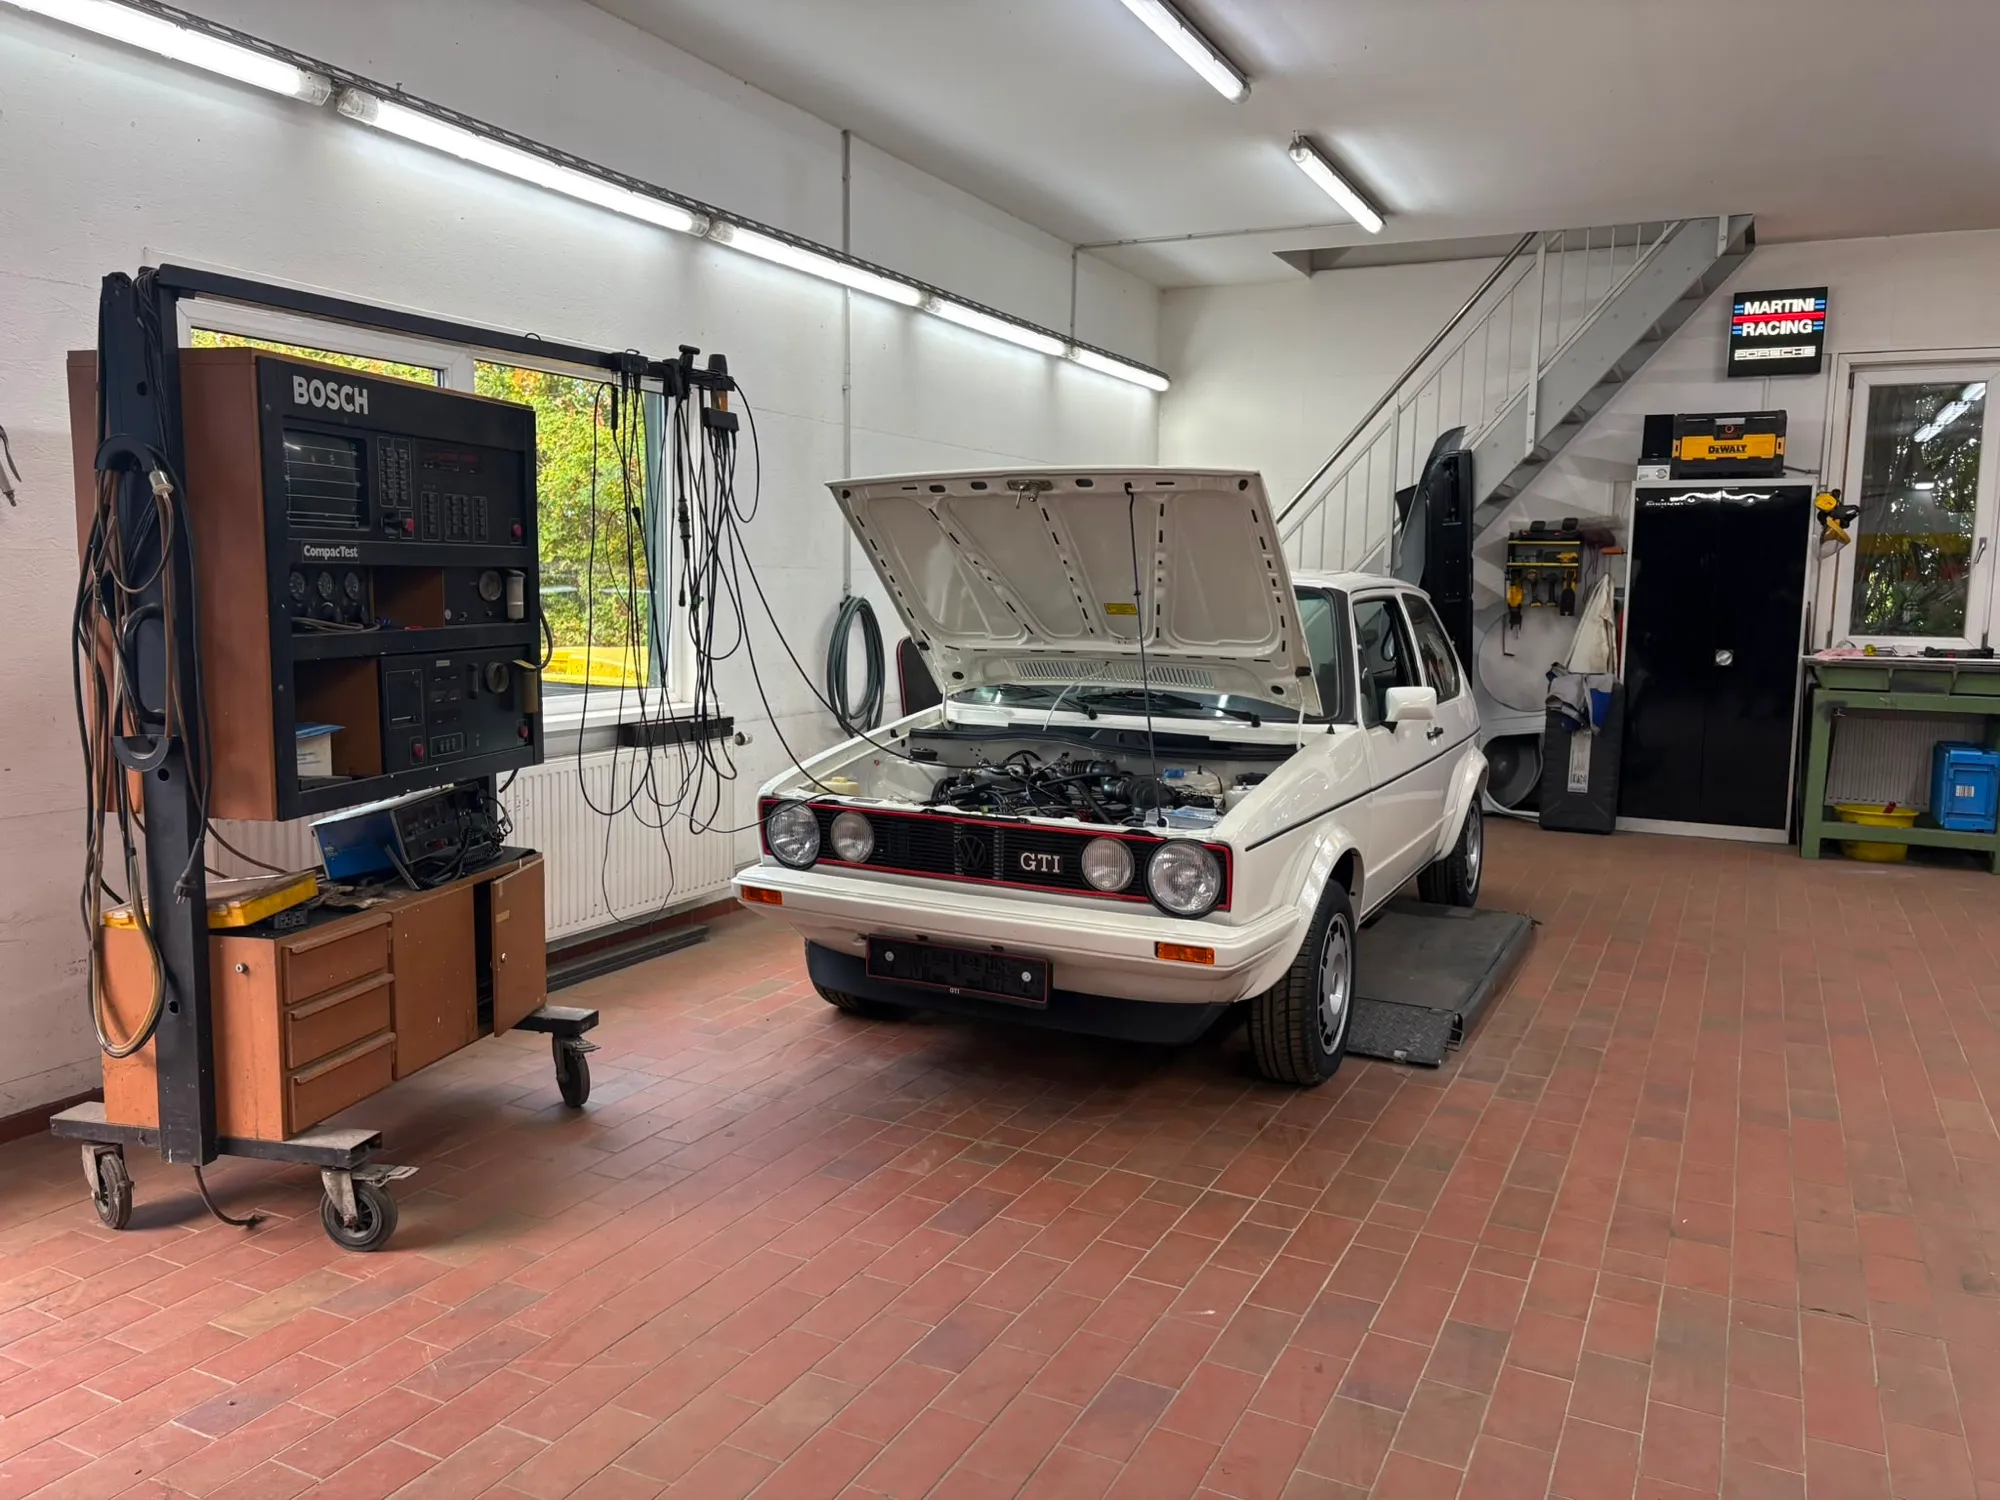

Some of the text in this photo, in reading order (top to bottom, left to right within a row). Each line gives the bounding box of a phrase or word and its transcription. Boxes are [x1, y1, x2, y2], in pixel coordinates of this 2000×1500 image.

[1743, 298, 1815, 315] MARTINI
[1742, 319, 1813, 337] RACING
[1734, 345, 1816, 361] PORSCHE
[293, 375, 369, 415] BOSCH
[303, 545, 358, 561] CompacTest
[1020, 852, 1061, 873] GTI
